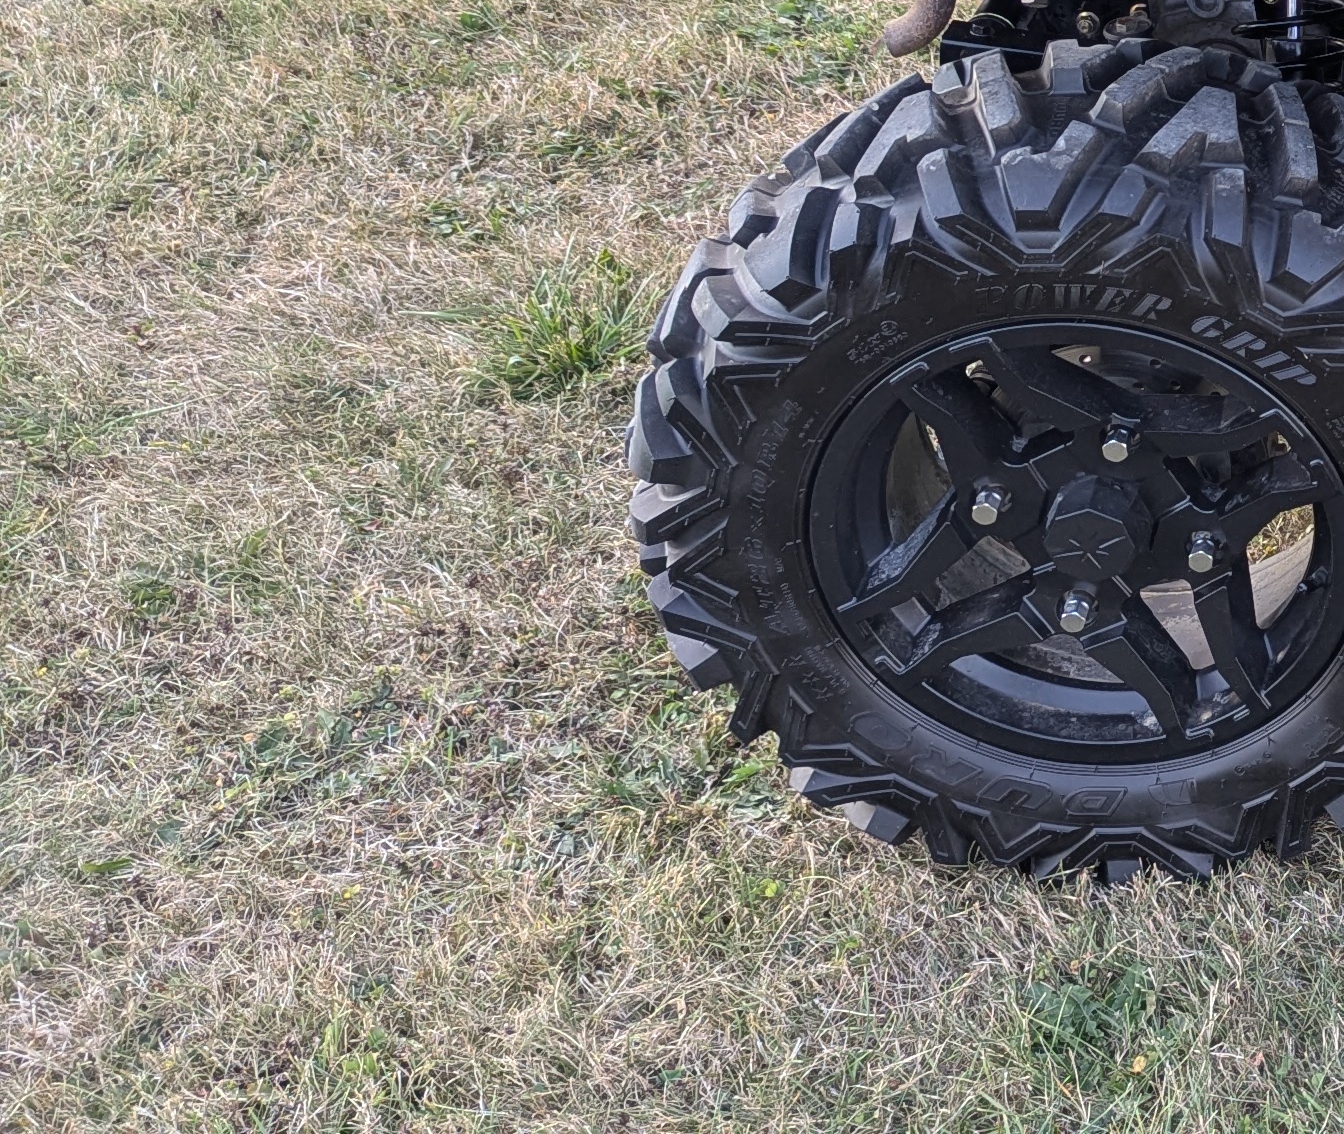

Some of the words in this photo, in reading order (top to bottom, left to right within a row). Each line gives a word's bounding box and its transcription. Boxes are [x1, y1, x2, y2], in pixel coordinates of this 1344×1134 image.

[977, 280, 1175, 321] POWER
[1189, 313, 1320, 389] GRIP
[853, 707, 1130, 821] DURO
